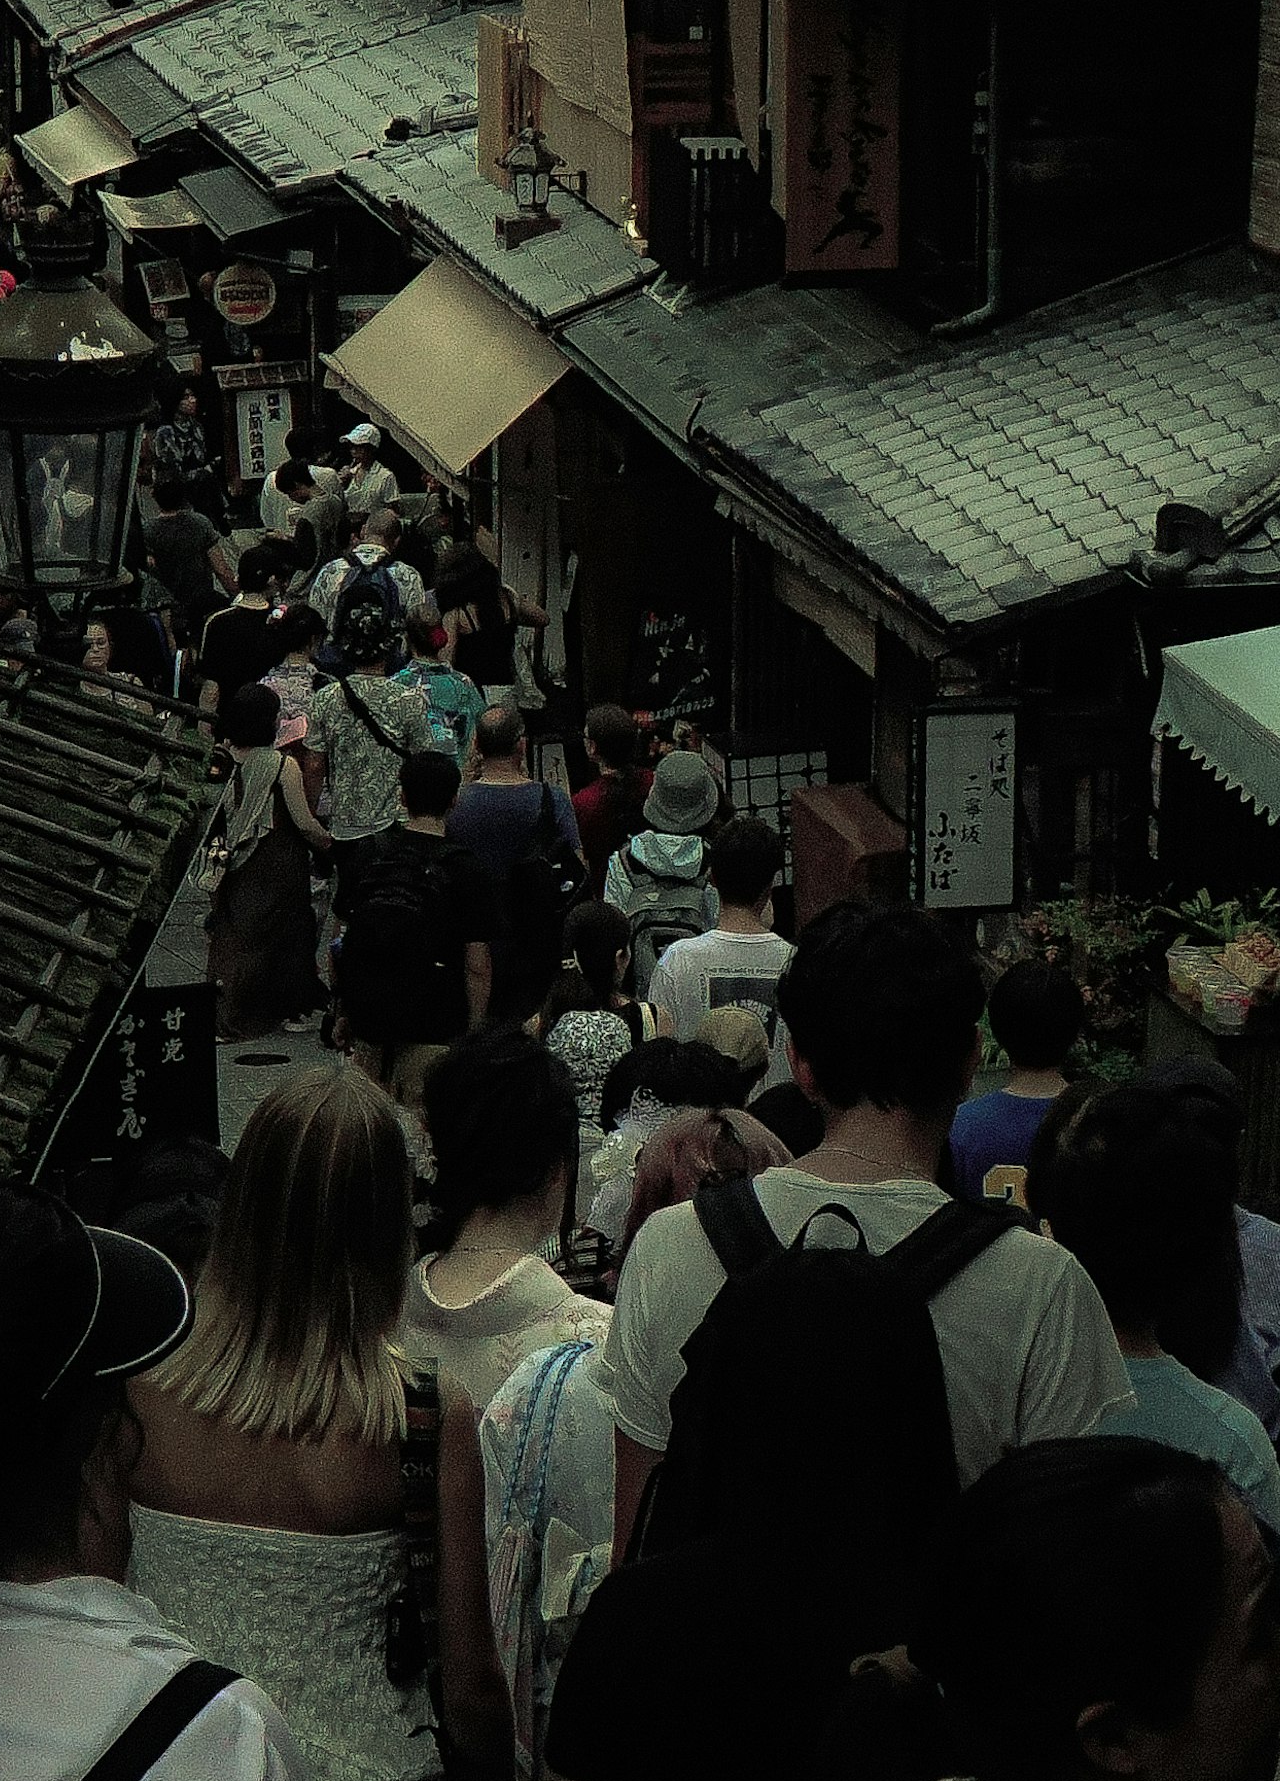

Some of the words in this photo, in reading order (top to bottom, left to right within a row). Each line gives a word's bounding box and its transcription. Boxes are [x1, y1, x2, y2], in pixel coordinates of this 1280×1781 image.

[989, 727, 1011, 800] そば処
[928, 811, 959, 891] ふたば
[160, 1005, 187, 1065] 甘党
